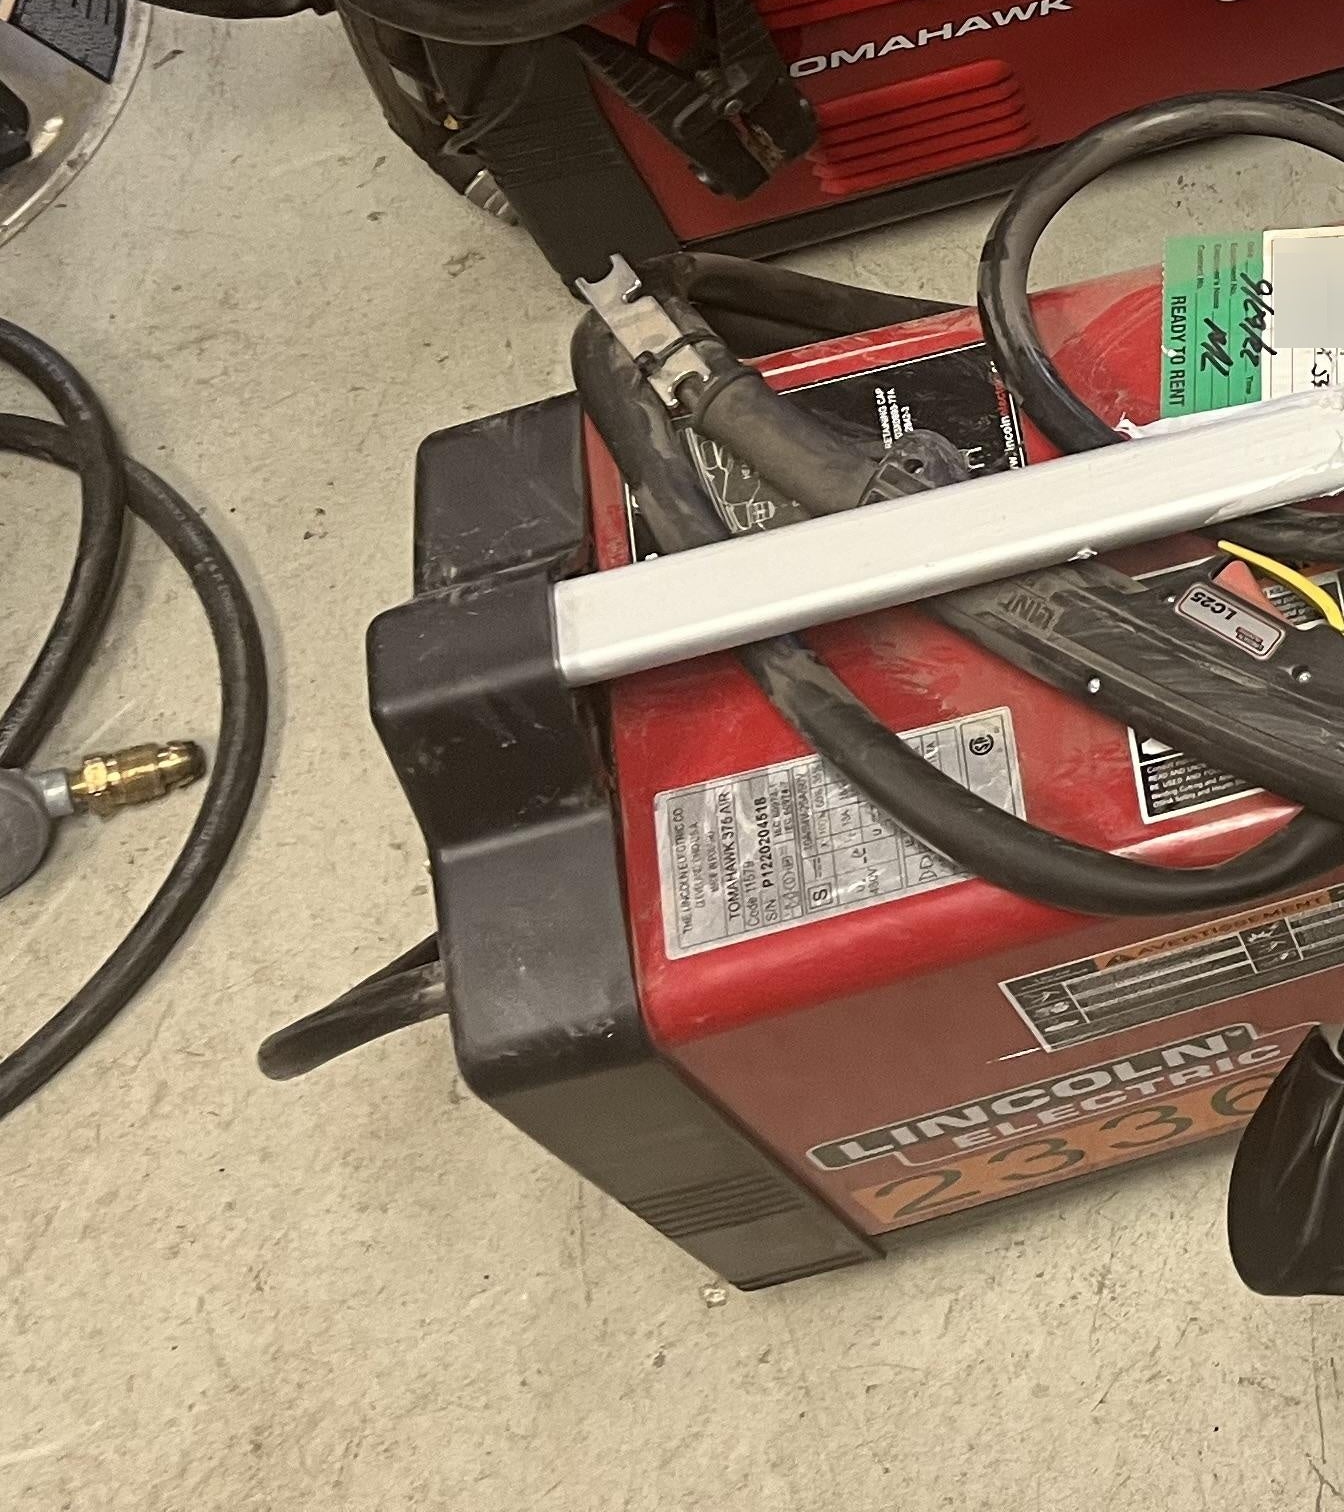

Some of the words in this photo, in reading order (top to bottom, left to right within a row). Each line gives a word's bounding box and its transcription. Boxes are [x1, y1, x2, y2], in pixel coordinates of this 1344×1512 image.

[1169, 295, 1186, 342] READY
[1169, 347, 1185, 365] TO
[874, 386, 886, 405] CAP
[1168, 369, 1185, 407] RENT
[1189, 588, 1237, 622] LC25
[717, 790, 732, 815] AIR
[718, 841, 744, 920] TOMAHAWK
[812, 887, 827, 901] S
[743, 896, 761, 926] Code
[763, 898, 778, 920] S/N
[841, 1034, 1227, 1161] LINCOLN
[953, 1044, 1282, 1151] ELECTRIC
